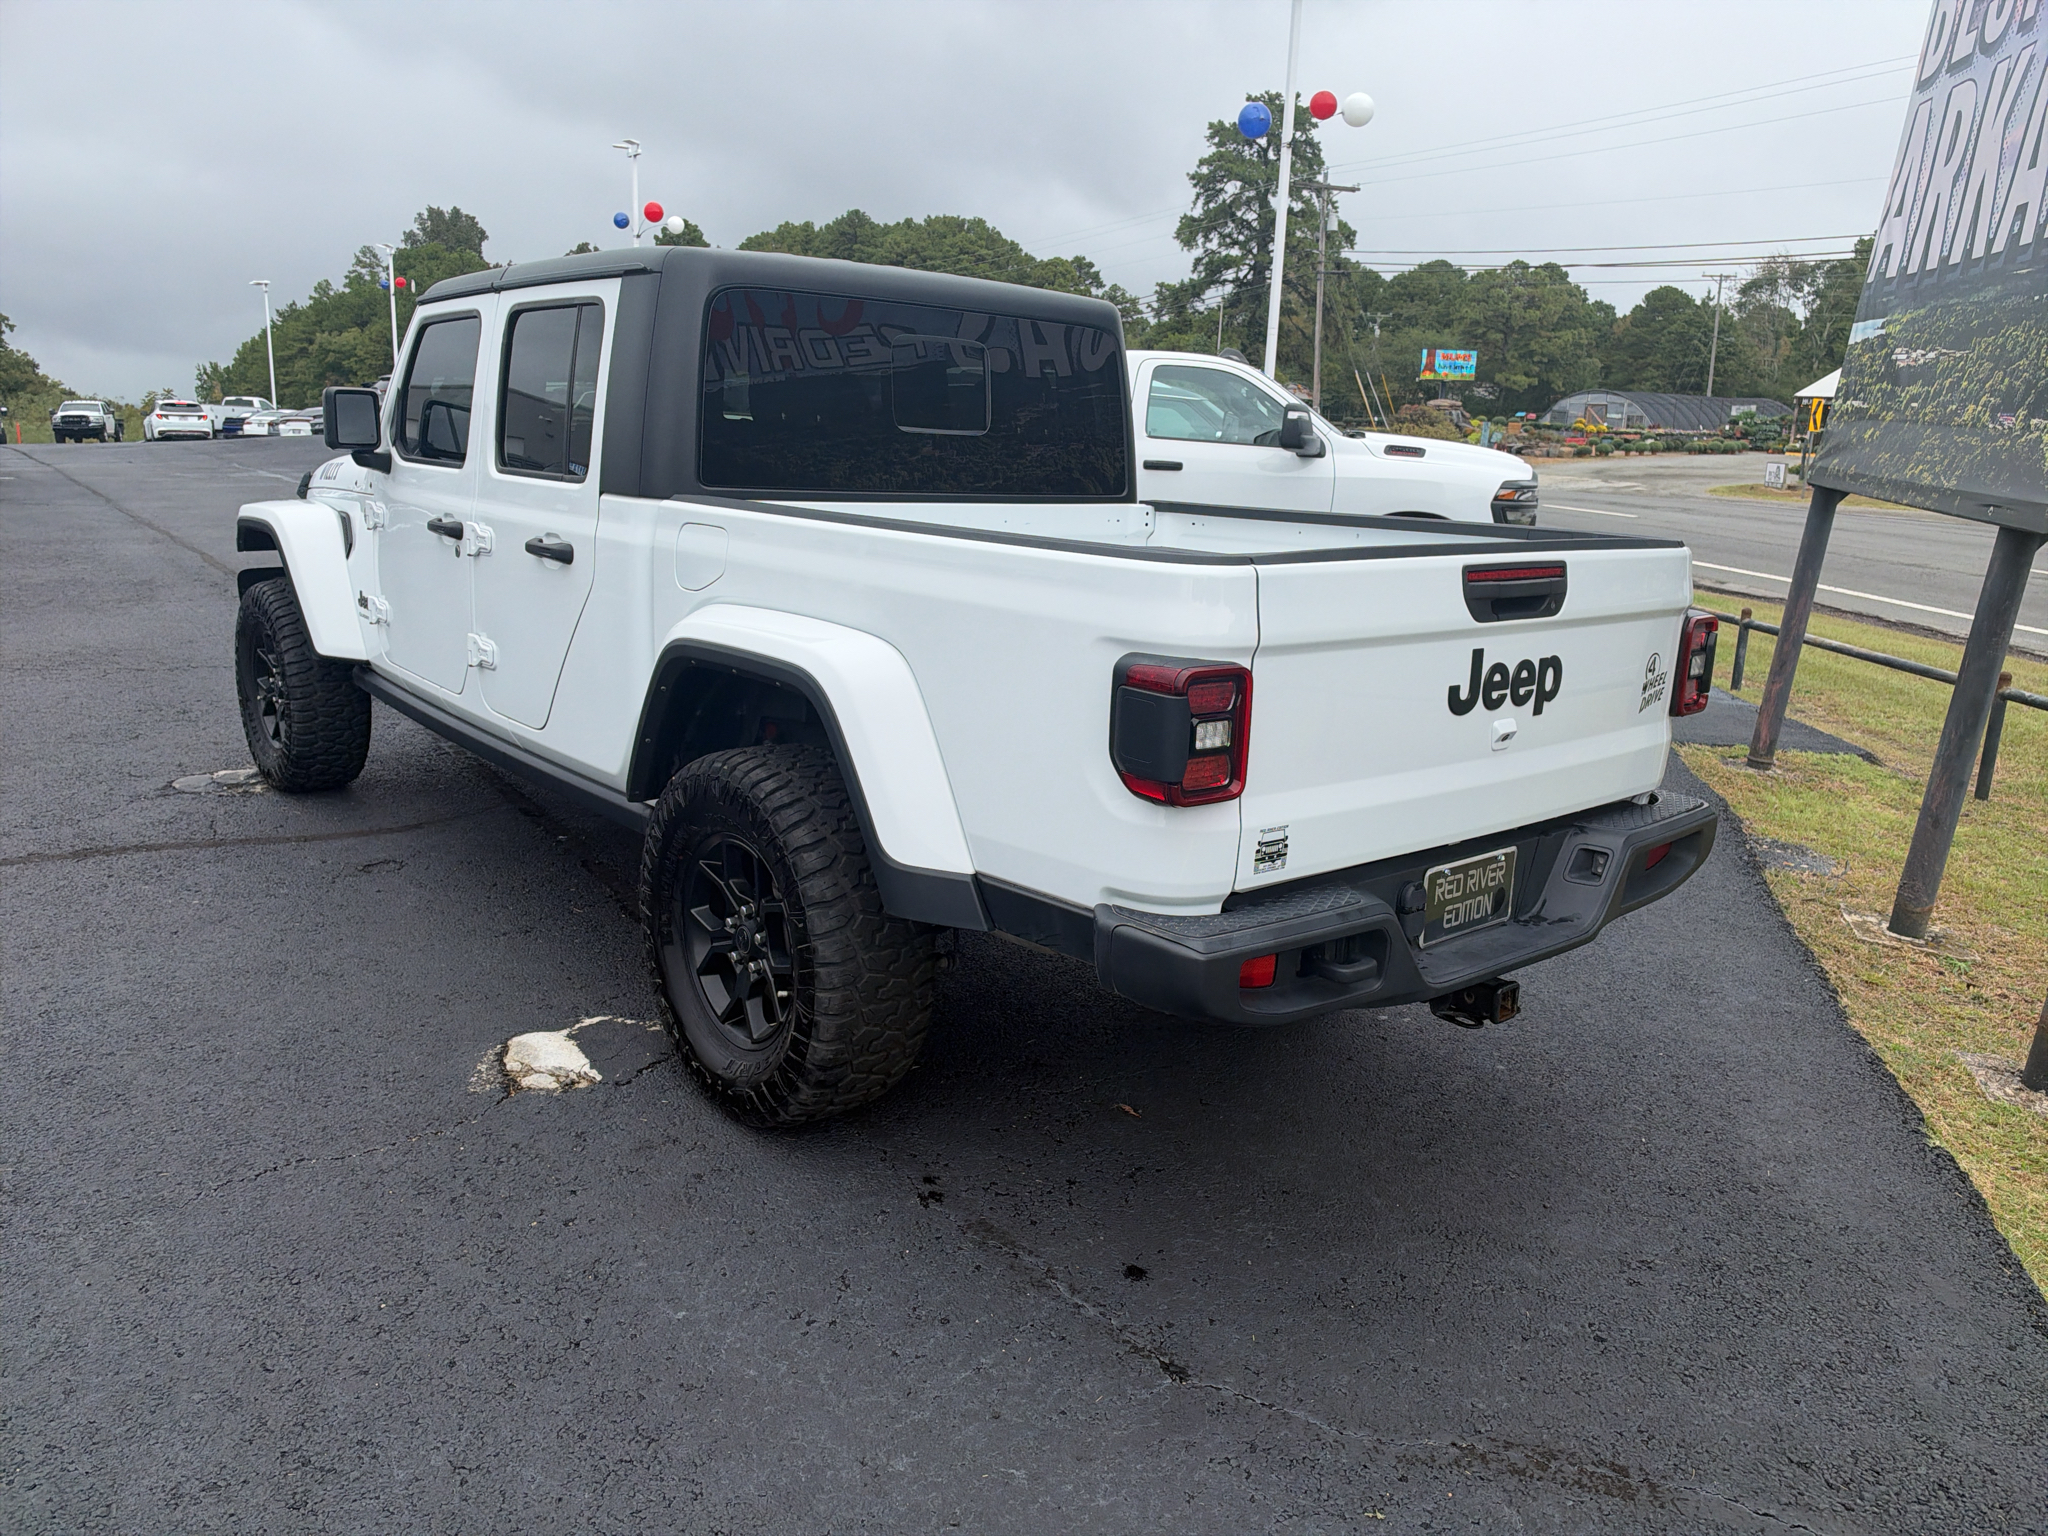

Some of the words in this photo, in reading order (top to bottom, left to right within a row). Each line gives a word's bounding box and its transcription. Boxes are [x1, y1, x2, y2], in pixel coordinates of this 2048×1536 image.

[1866, 41, 2048, 284] ARKA
[1447, 648, 1563, 716] Jeep
[1641, 671, 1668, 696] WHEEL
[1647, 656, 1657, 676] 4
[1638, 687, 1666, 714] DRIVE
[1434, 873, 1464, 905] RED
[1466, 861, 1506, 894] RIVER
[1443, 892, 1494, 929] EDITION
